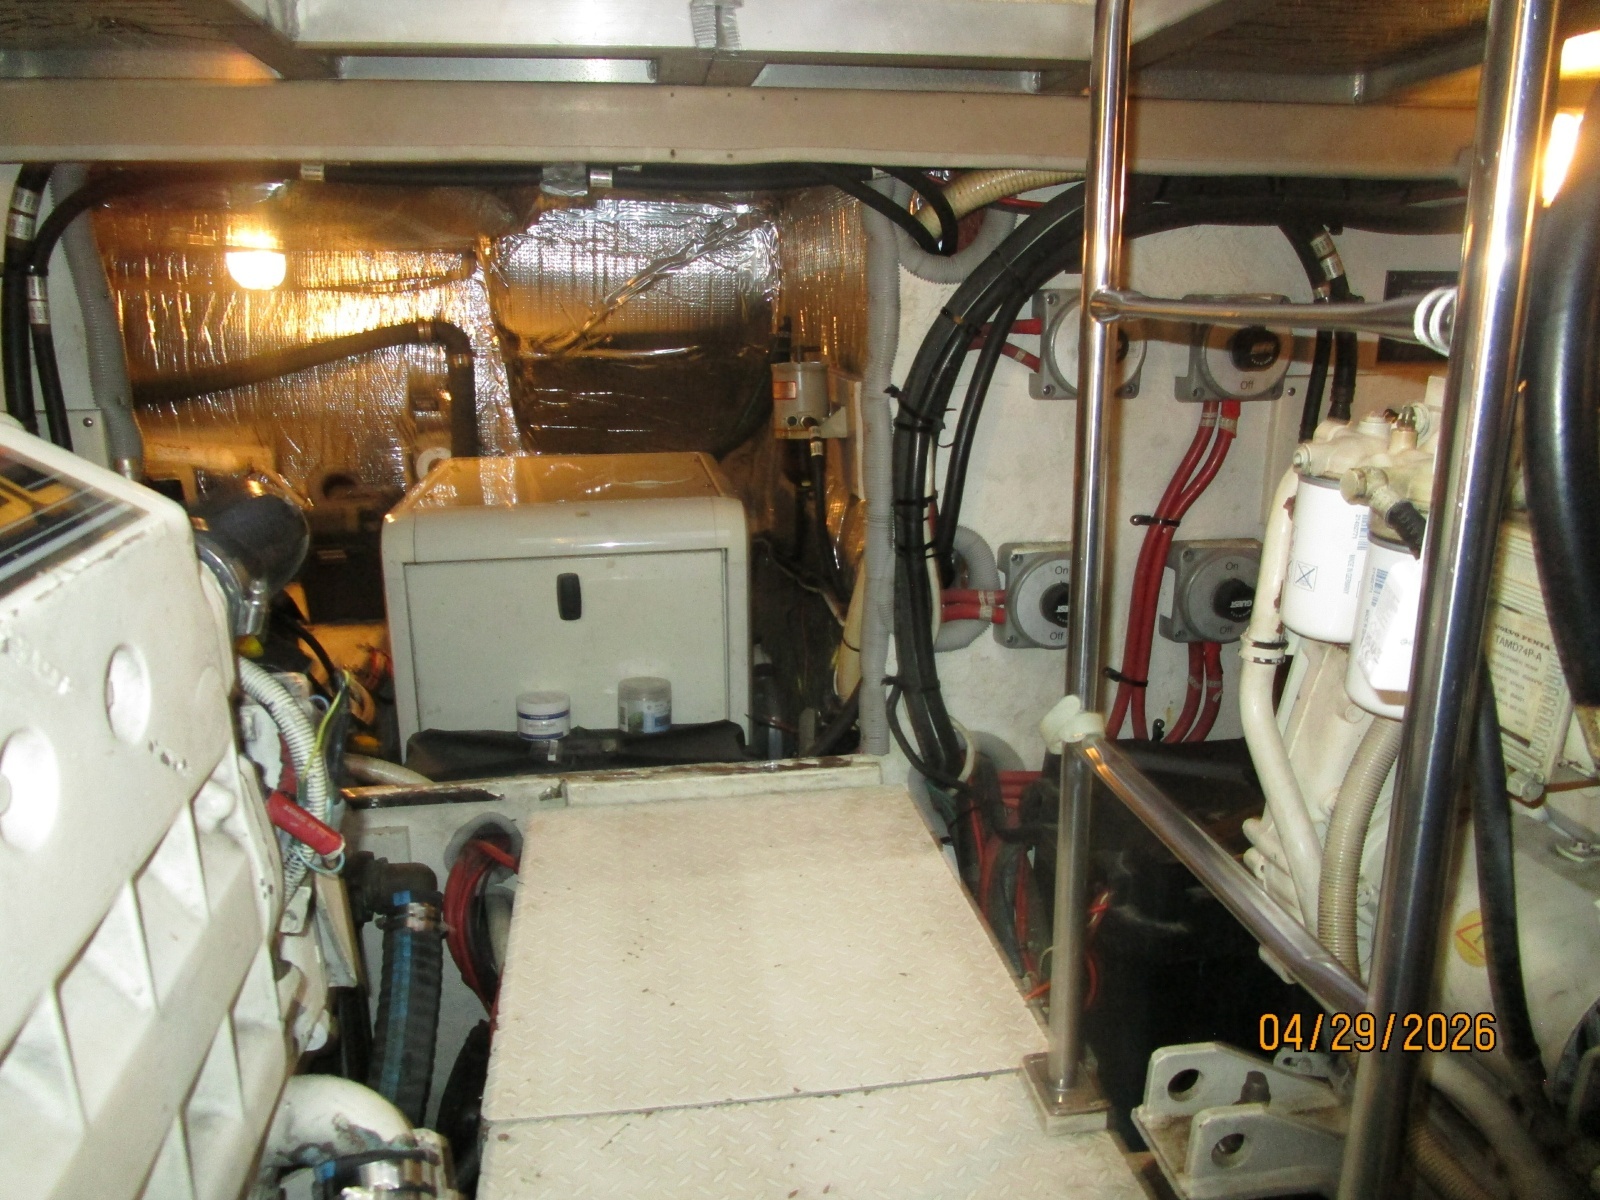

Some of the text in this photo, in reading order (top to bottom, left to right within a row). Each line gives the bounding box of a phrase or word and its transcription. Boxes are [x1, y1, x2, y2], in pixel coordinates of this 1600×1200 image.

[1240, 380, 1254, 390] Off
[1054, 565, 1069, 575] On
[1225, 562, 1239, 571] On
[1219, 626, 1235, 635] Off
[1049, 631, 1064, 641] Off
[1521, 634, 1550, 651] PENTA
